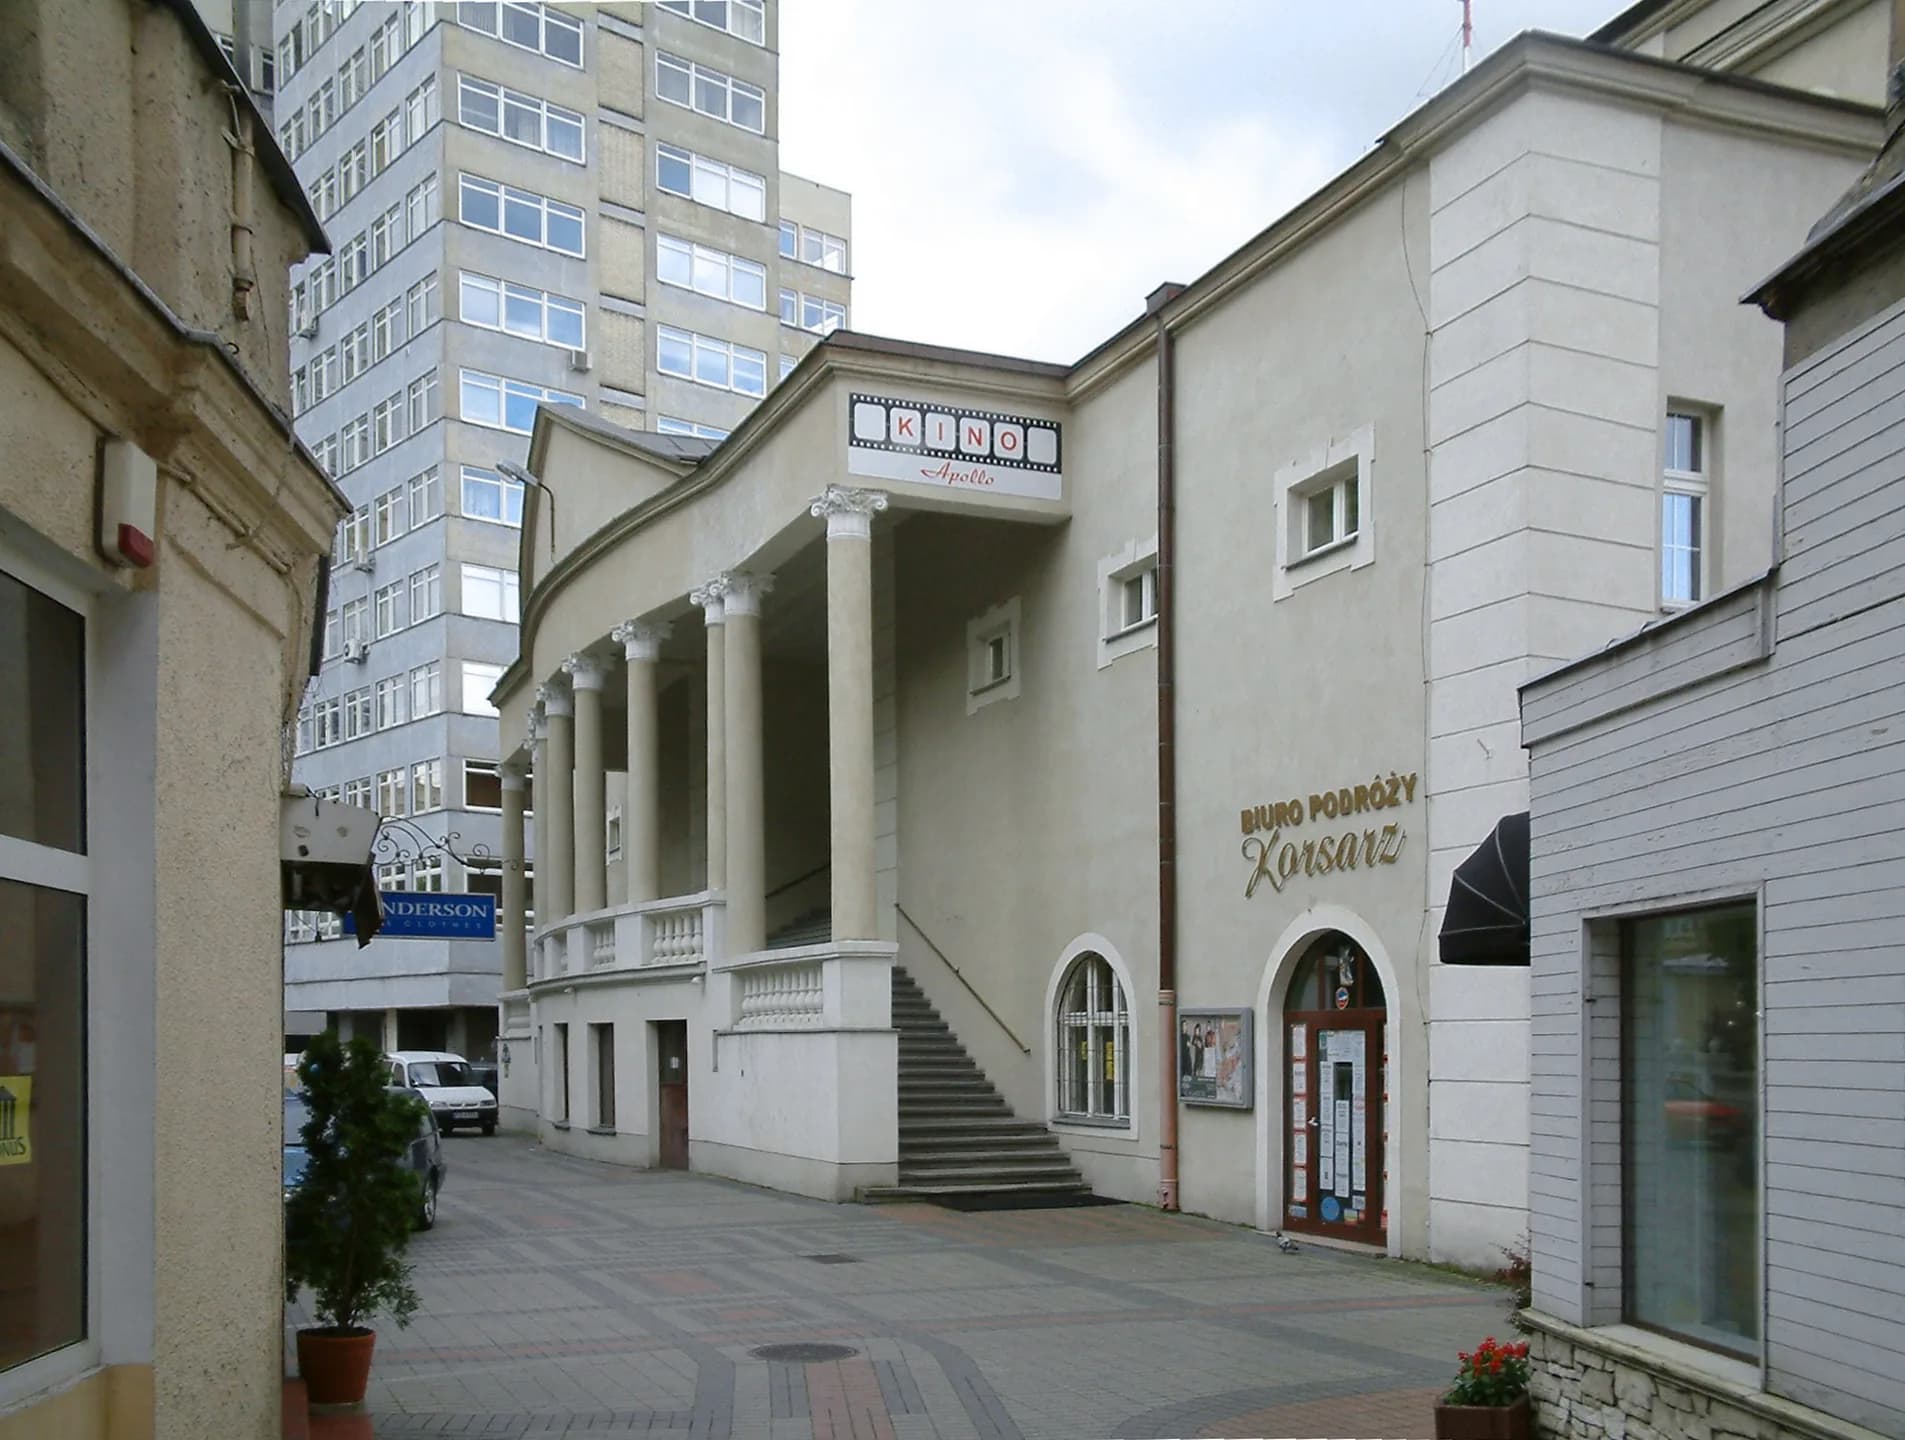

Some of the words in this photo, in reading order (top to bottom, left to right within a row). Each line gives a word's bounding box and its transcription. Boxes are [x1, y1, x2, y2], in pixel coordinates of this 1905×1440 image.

[898, 416, 1017, 451] KINO
[920, 461, 994, 485] Apollo
[1241, 799, 1304, 835] BIURO
[1308, 770, 1417, 822] PODRÓŻY
[1241, 822, 1407, 899] Korsarz
[382, 902, 487, 918] NDERSON
